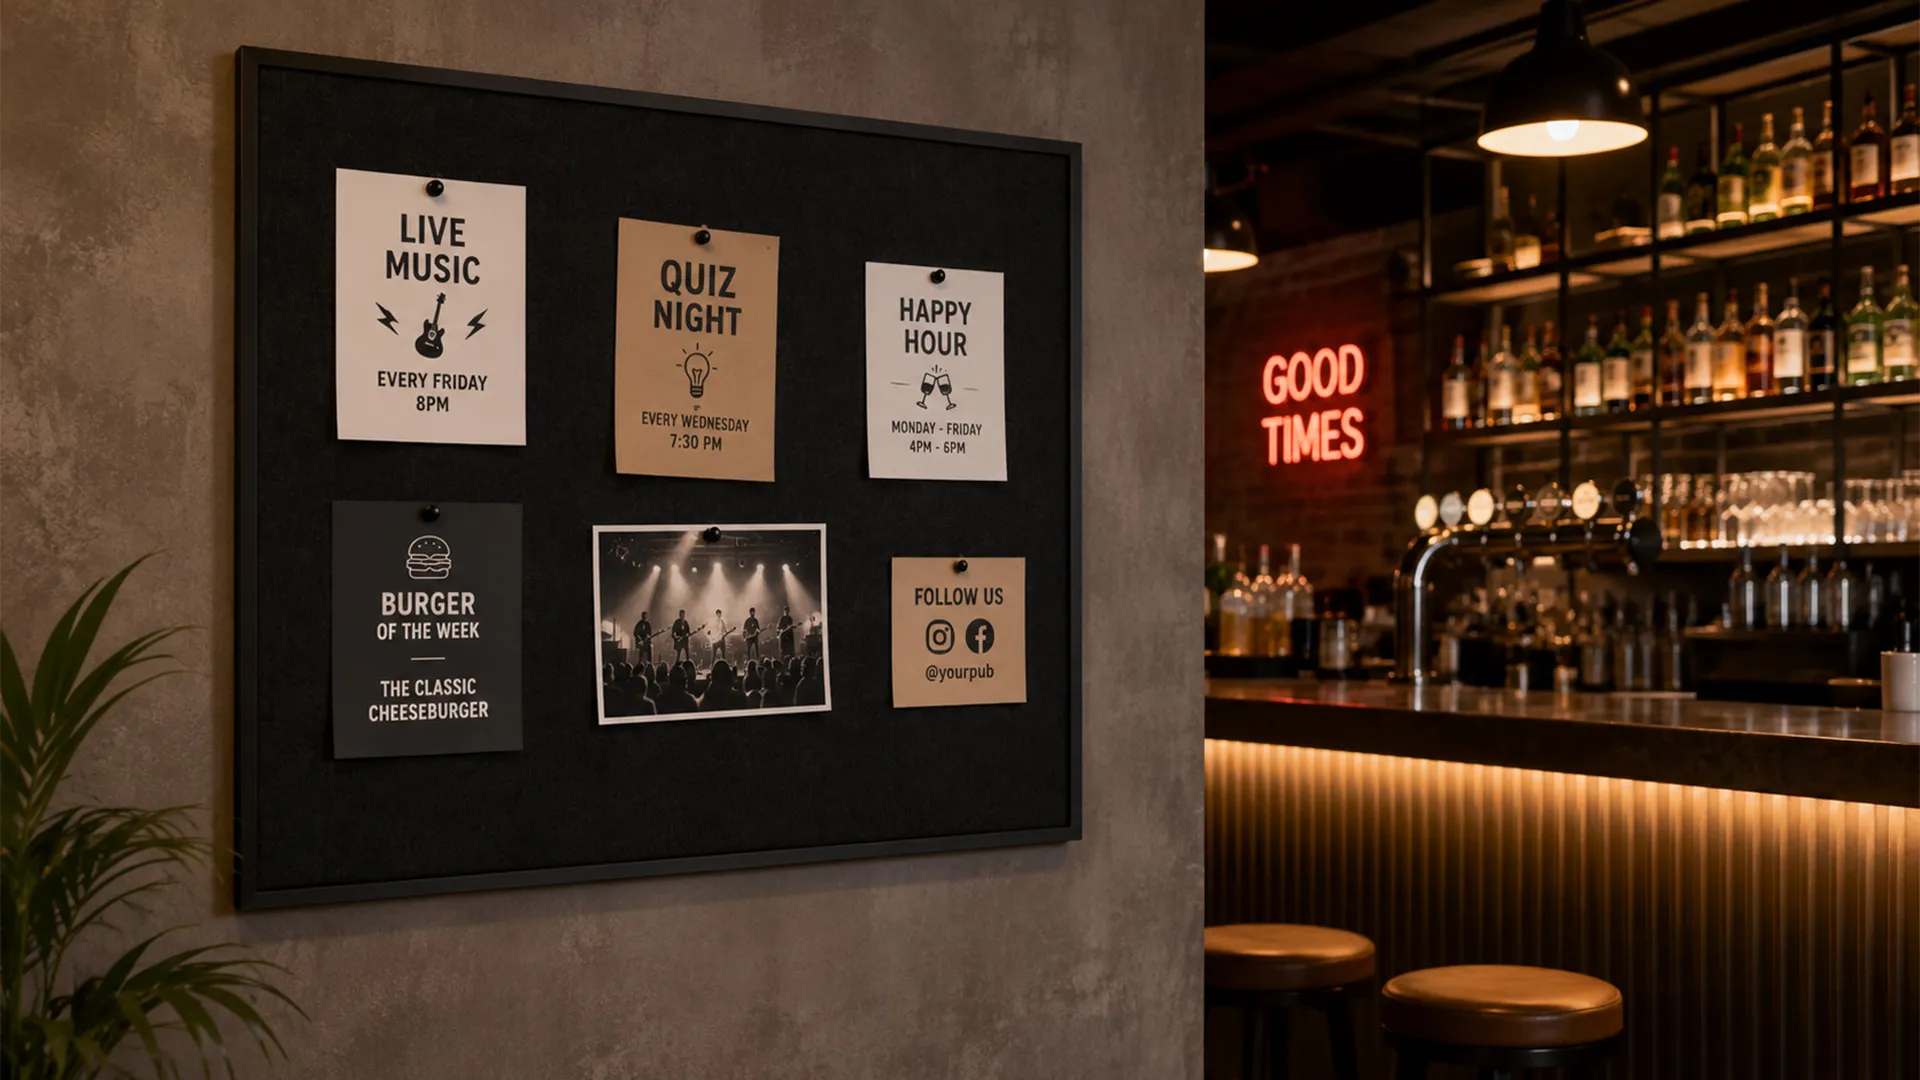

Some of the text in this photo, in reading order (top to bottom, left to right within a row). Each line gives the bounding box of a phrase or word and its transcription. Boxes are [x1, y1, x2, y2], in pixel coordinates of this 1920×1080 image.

[400, 213, 466, 248] LIVE
[385, 250, 481, 286] MUSIC
[660, 259, 737, 299] QUIZ
[653, 300, 742, 336] NIGHT
[900, 297, 972, 325] HAPPY
[904, 328, 968, 356] HOUR
[377, 370, 488, 391] EVERY FRIDAY
[1262, 343, 1365, 405] GOOD
[416, 396, 449, 412] 8PM
[641, 411, 750, 433] EVERY WEDNESDAY
[891, 420, 936, 435] MONDAY
[946, 422, 982, 436] FRIDAY
[669, 433, 722, 451] 7:30 PM
[1261, 406, 1365, 466] TIMES
[909, 440, 932, 453] 4PM
[943, 441, 966, 454] 6PM
[381, 591, 476, 617] BURGER
[914, 587, 1004, 606] FOLLOW US
[376, 621, 480, 640] OF THE WEEK
[925, 663, 995, 683] @yourpub
[380, 678, 477, 697] THE CLASSIC
[368, 701, 489, 722] CHEESEBURGER
